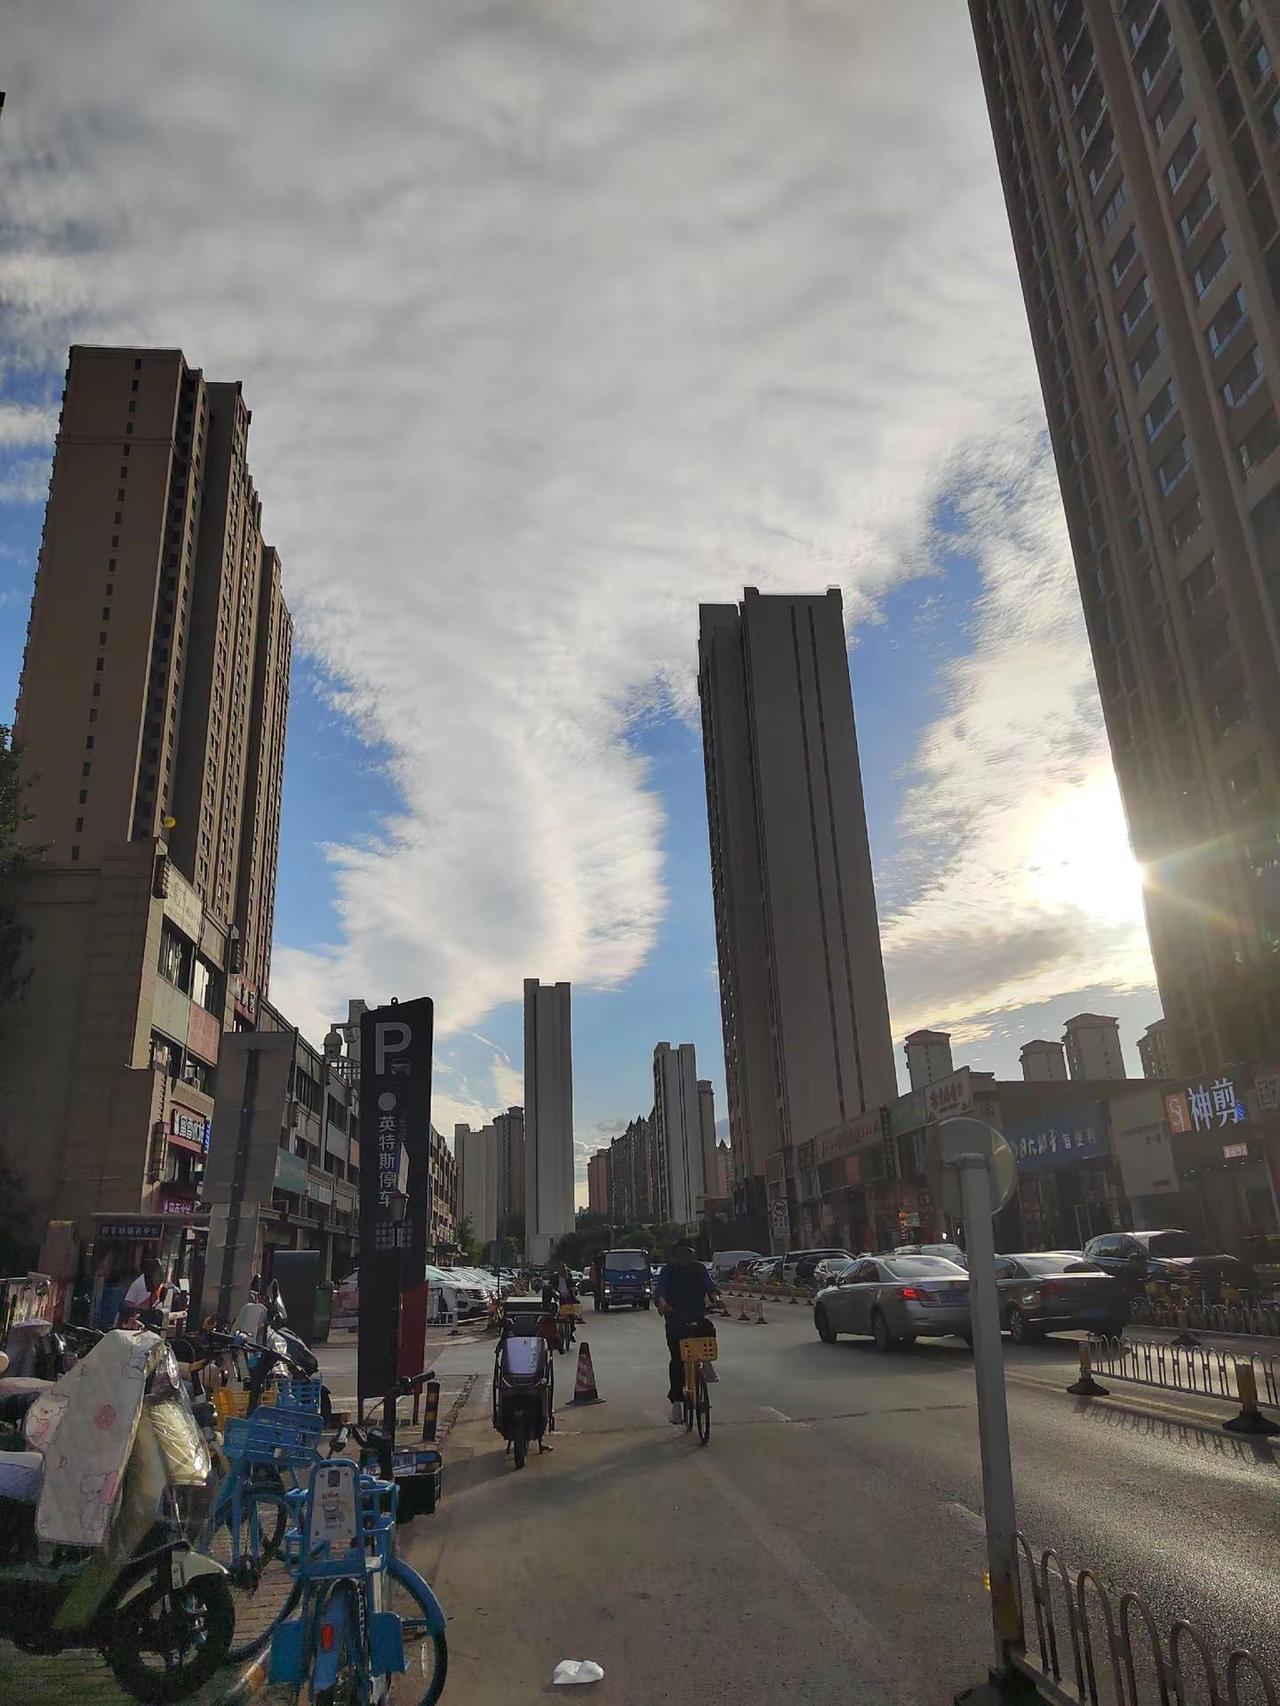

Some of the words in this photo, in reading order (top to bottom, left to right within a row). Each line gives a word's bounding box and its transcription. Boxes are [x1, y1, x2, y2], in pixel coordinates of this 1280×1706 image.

[375, 1021, 413, 1075] P
[1187, 1077, 1239, 1132] 神剪
[378, 1115, 396, 1208] 英特斯停车
